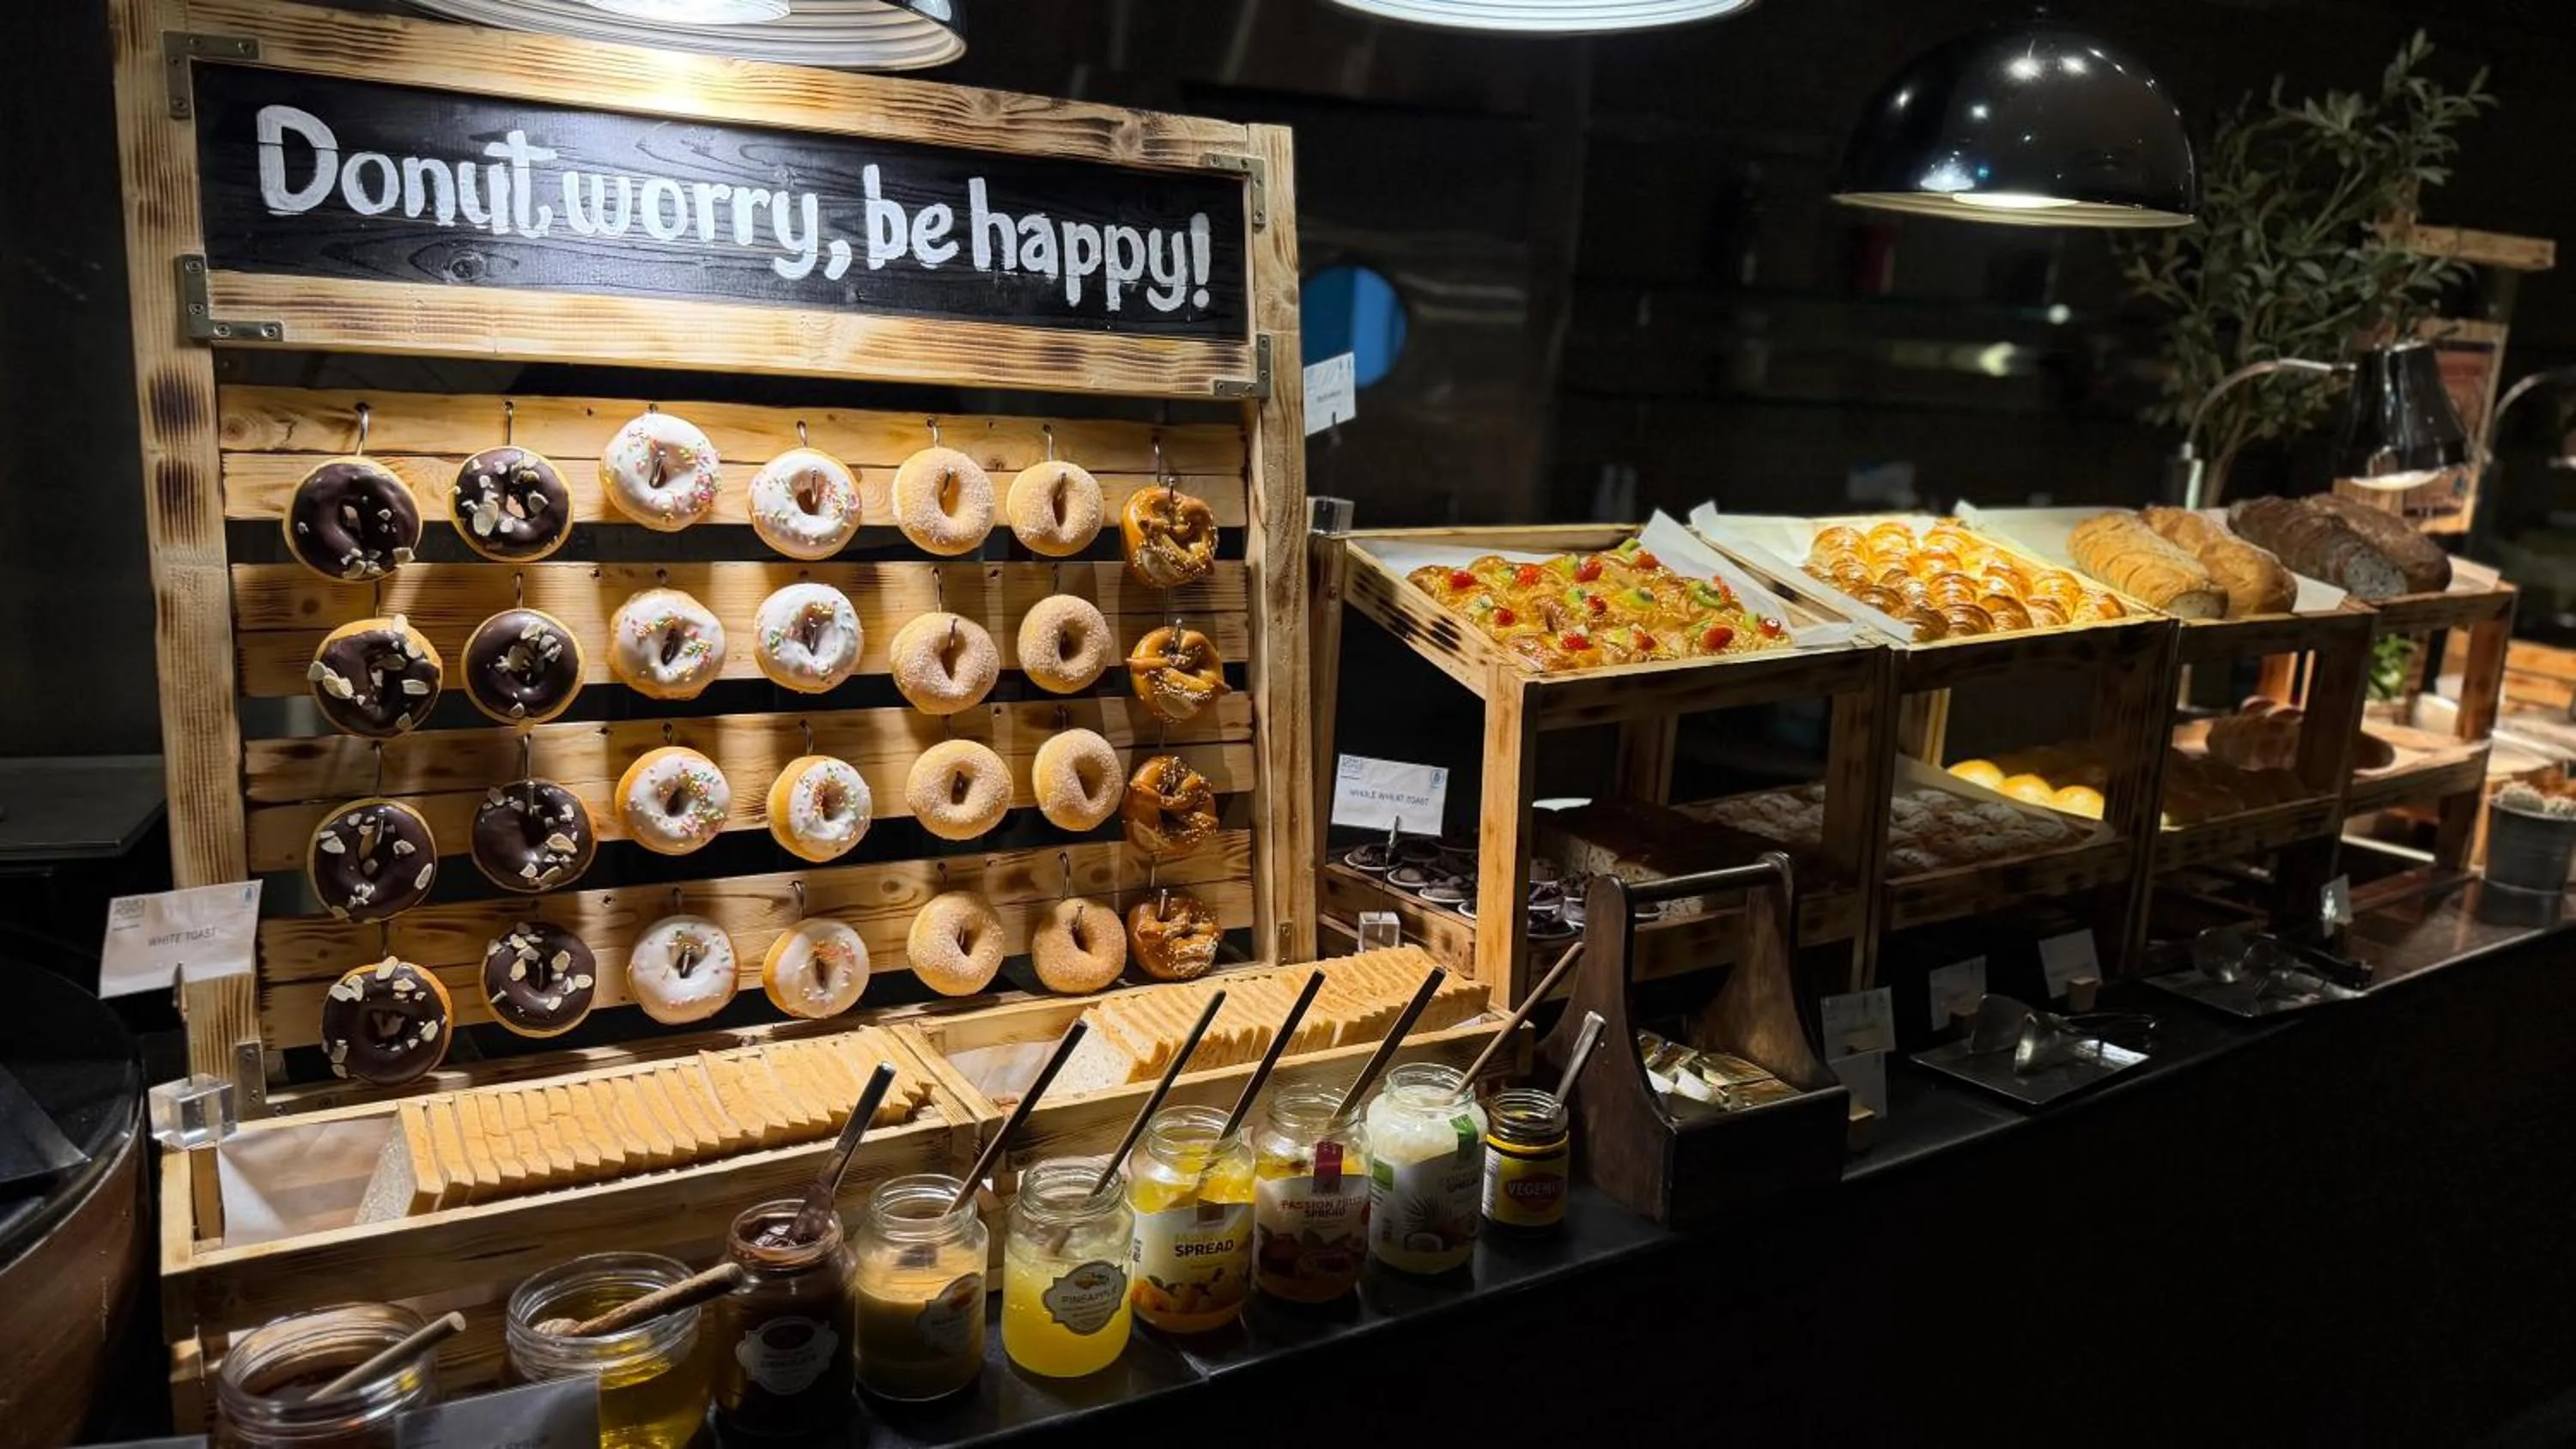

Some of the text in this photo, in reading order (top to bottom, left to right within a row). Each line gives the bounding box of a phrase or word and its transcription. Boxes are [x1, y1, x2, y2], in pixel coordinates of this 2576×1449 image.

[257, 105, 1211, 312] Donut worry, be happy!
[1406, 796, 1430, 807] TOAST
[148, 926, 218, 948] WHITE TOAST
[1174, 1239, 1235, 1258] SPREAD
